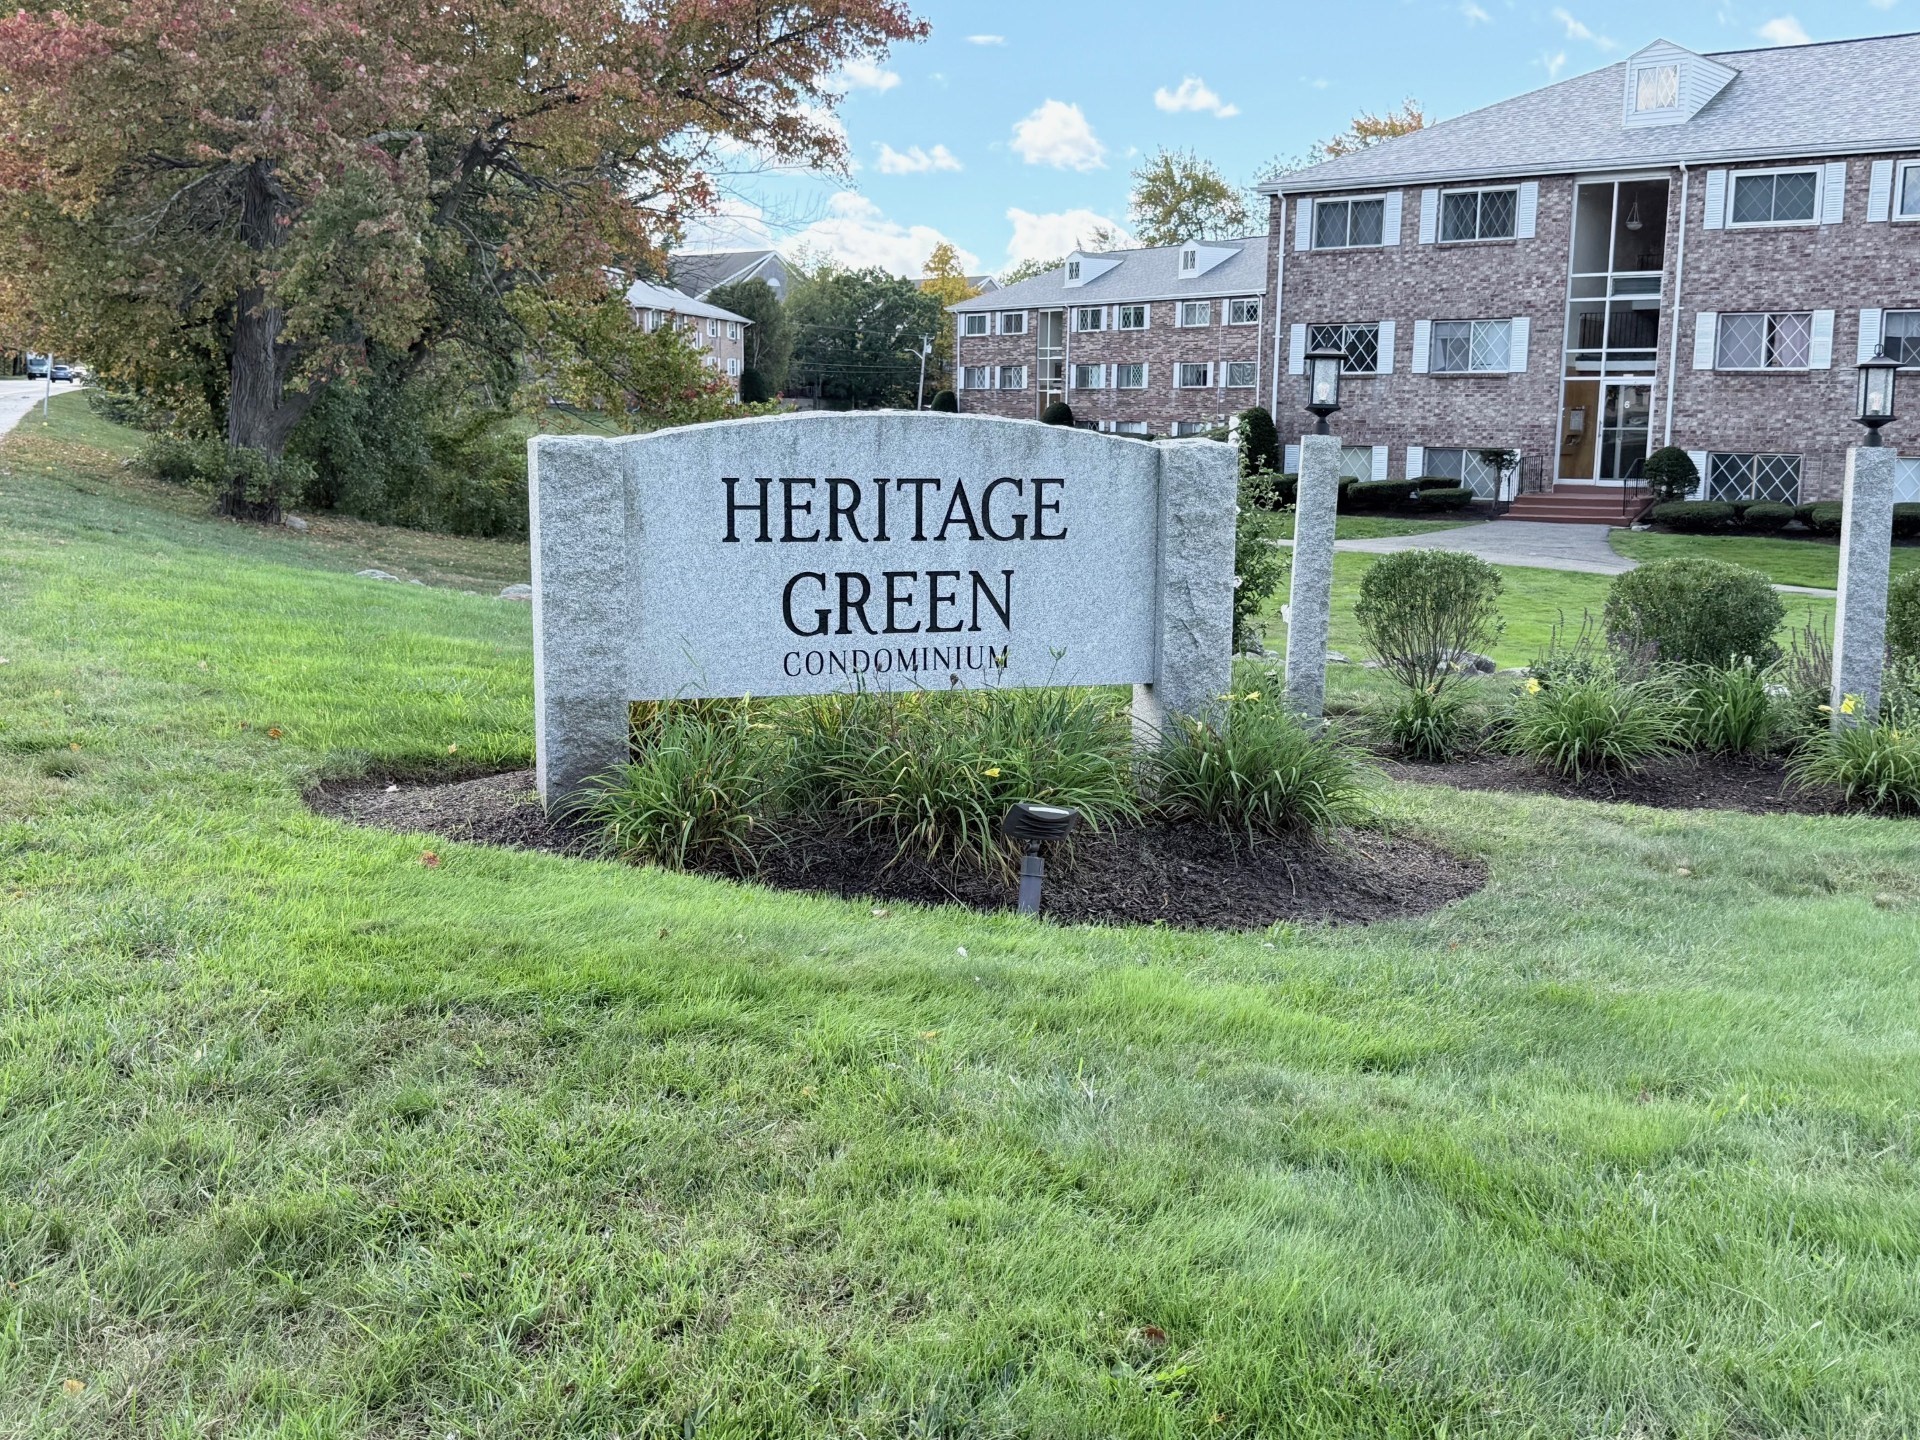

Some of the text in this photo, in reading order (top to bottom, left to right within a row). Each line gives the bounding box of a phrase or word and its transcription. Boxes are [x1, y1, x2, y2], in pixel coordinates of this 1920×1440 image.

[1624, 400, 1631, 409] 6
[721, 477, 1068, 543] HERITAGE
[782, 570, 1015, 637] GREEN
[783, 644, 1009, 677] CONDOMINIUM
